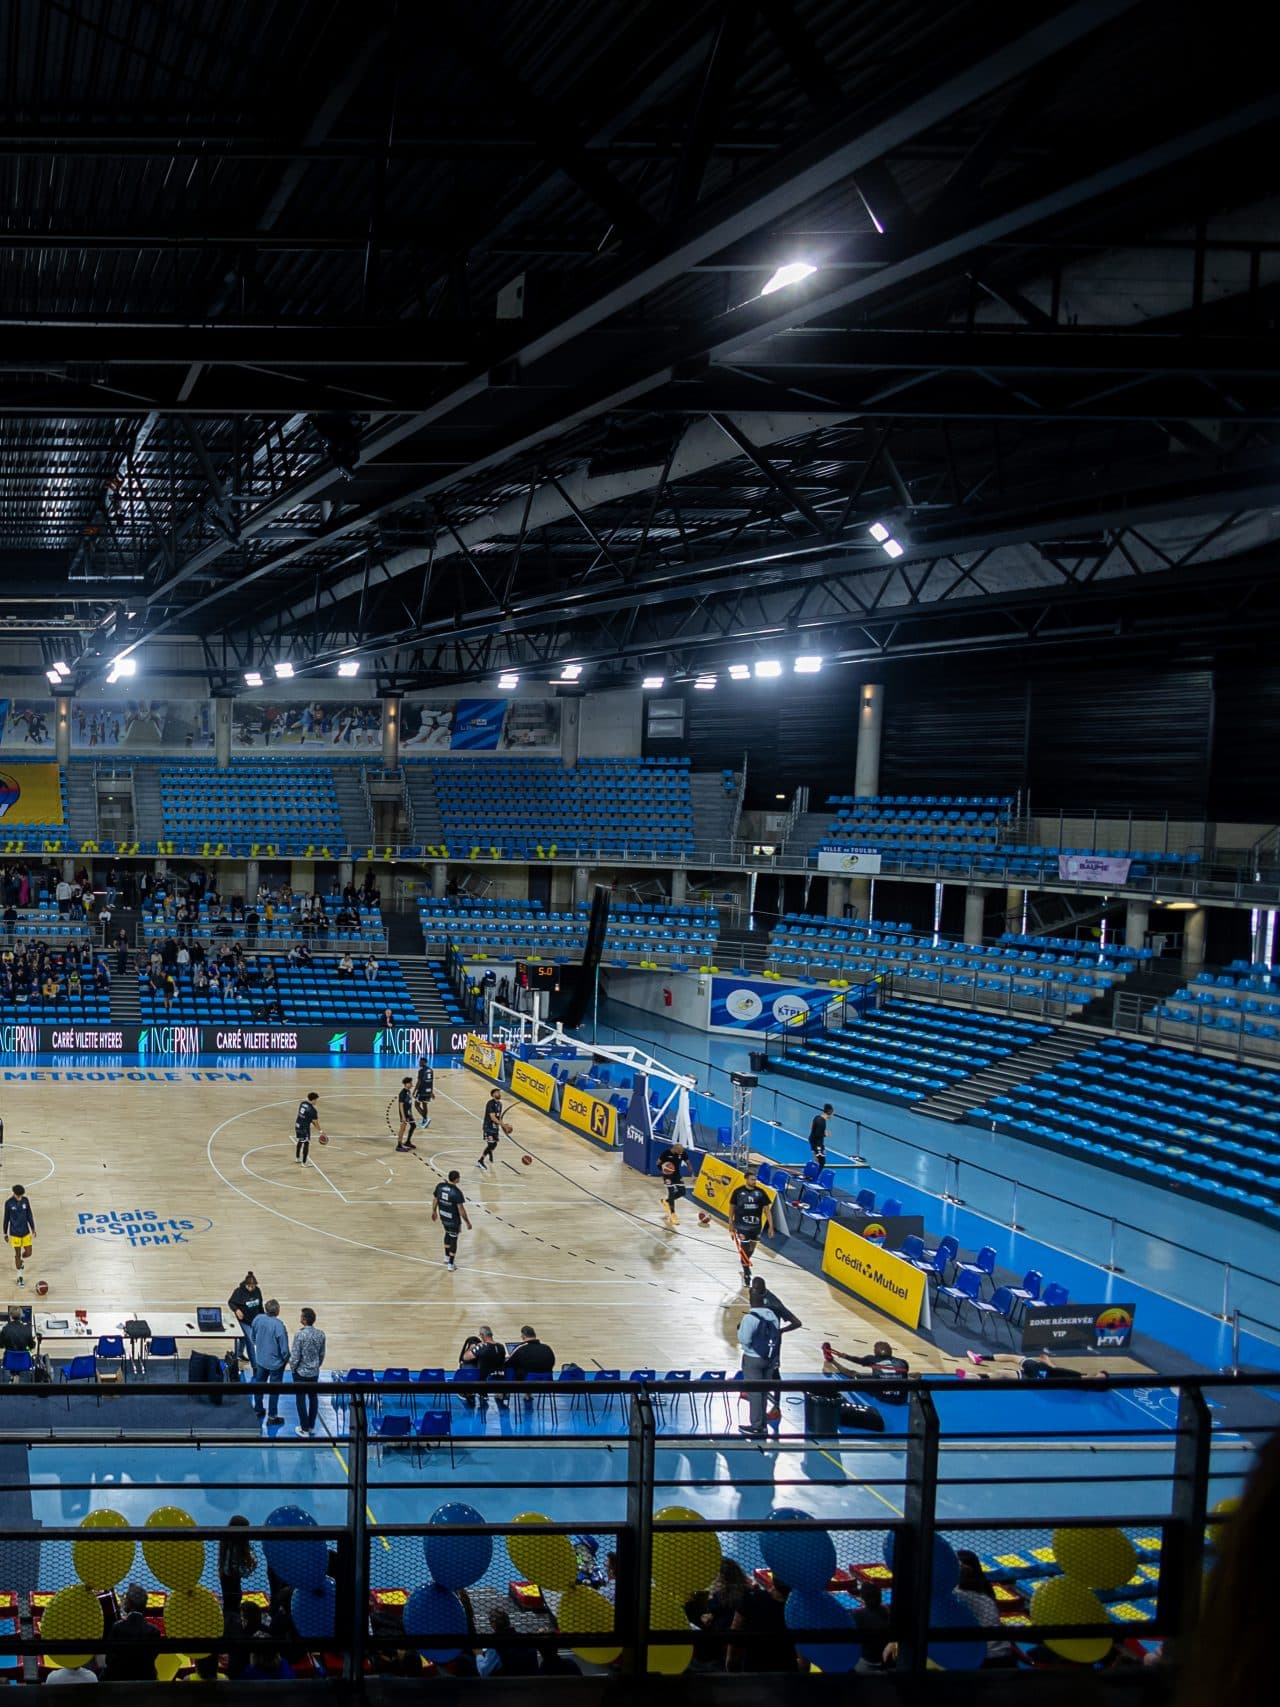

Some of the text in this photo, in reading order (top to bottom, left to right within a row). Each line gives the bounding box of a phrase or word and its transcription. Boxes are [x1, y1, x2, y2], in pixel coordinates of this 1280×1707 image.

[51, 1027, 74, 1048] CARRÉ
[99, 1031, 123, 1048] HYERES
[216, 1028, 242, 1048] CARRÉ
[270, 1032, 297, 1049] HYERES
[185, 1071, 253, 1082] TPM
[568, 1098, 588, 1118] sade
[77, 1208, 158, 1225] Palais
[75, 1218, 195, 1237] des Sports
[126, 1234, 172, 1247] TPM
[834, 1247, 909, 1301] Crédit Mutuel
[1030, 1319, 1050, 1327] ZONE
[1053, 1330, 1067, 1338] VIP
[1097, 1335, 1125, 1347] HTV
